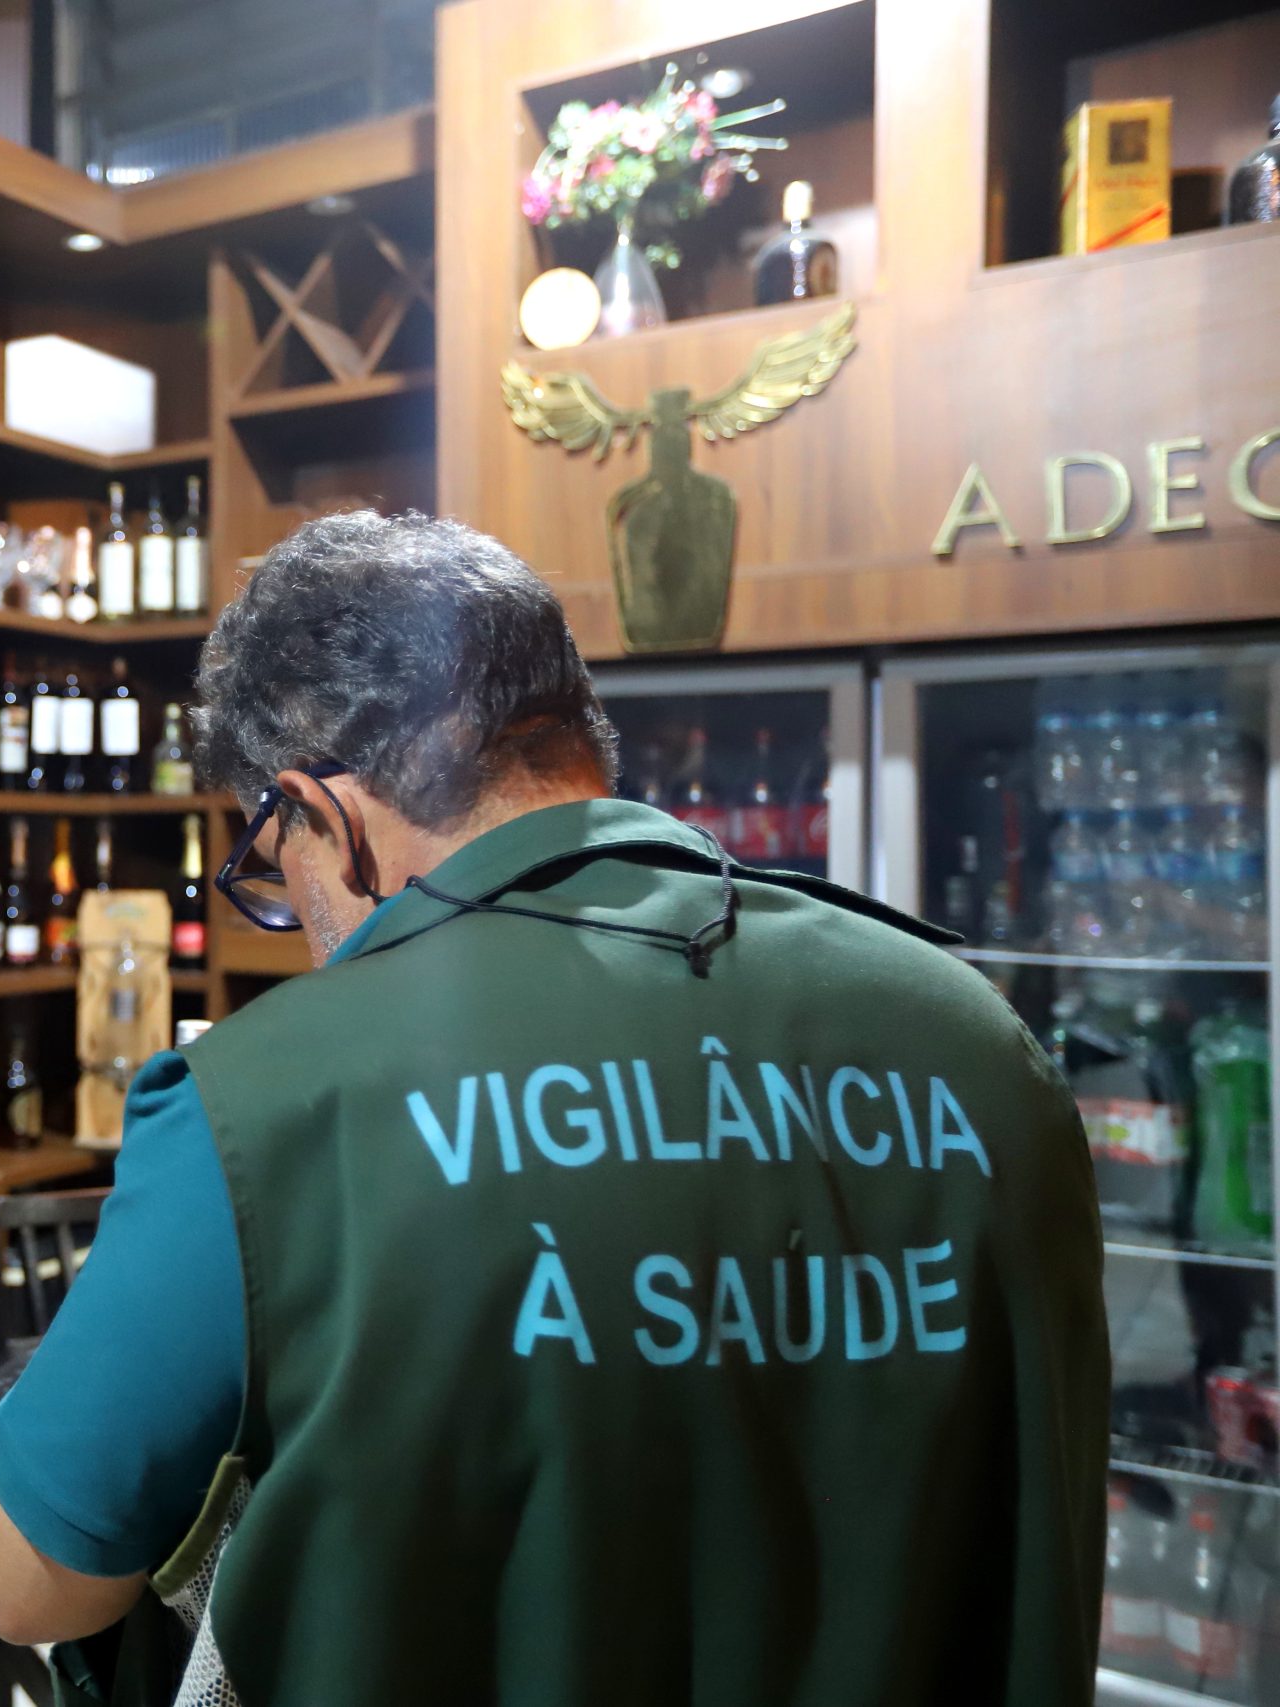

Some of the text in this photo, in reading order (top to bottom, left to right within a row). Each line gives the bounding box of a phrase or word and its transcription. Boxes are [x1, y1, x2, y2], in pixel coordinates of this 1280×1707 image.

[406, 1035, 993, 1185] VIGILÂNCIA
[513, 1222, 967, 1366] À SAÚDE
